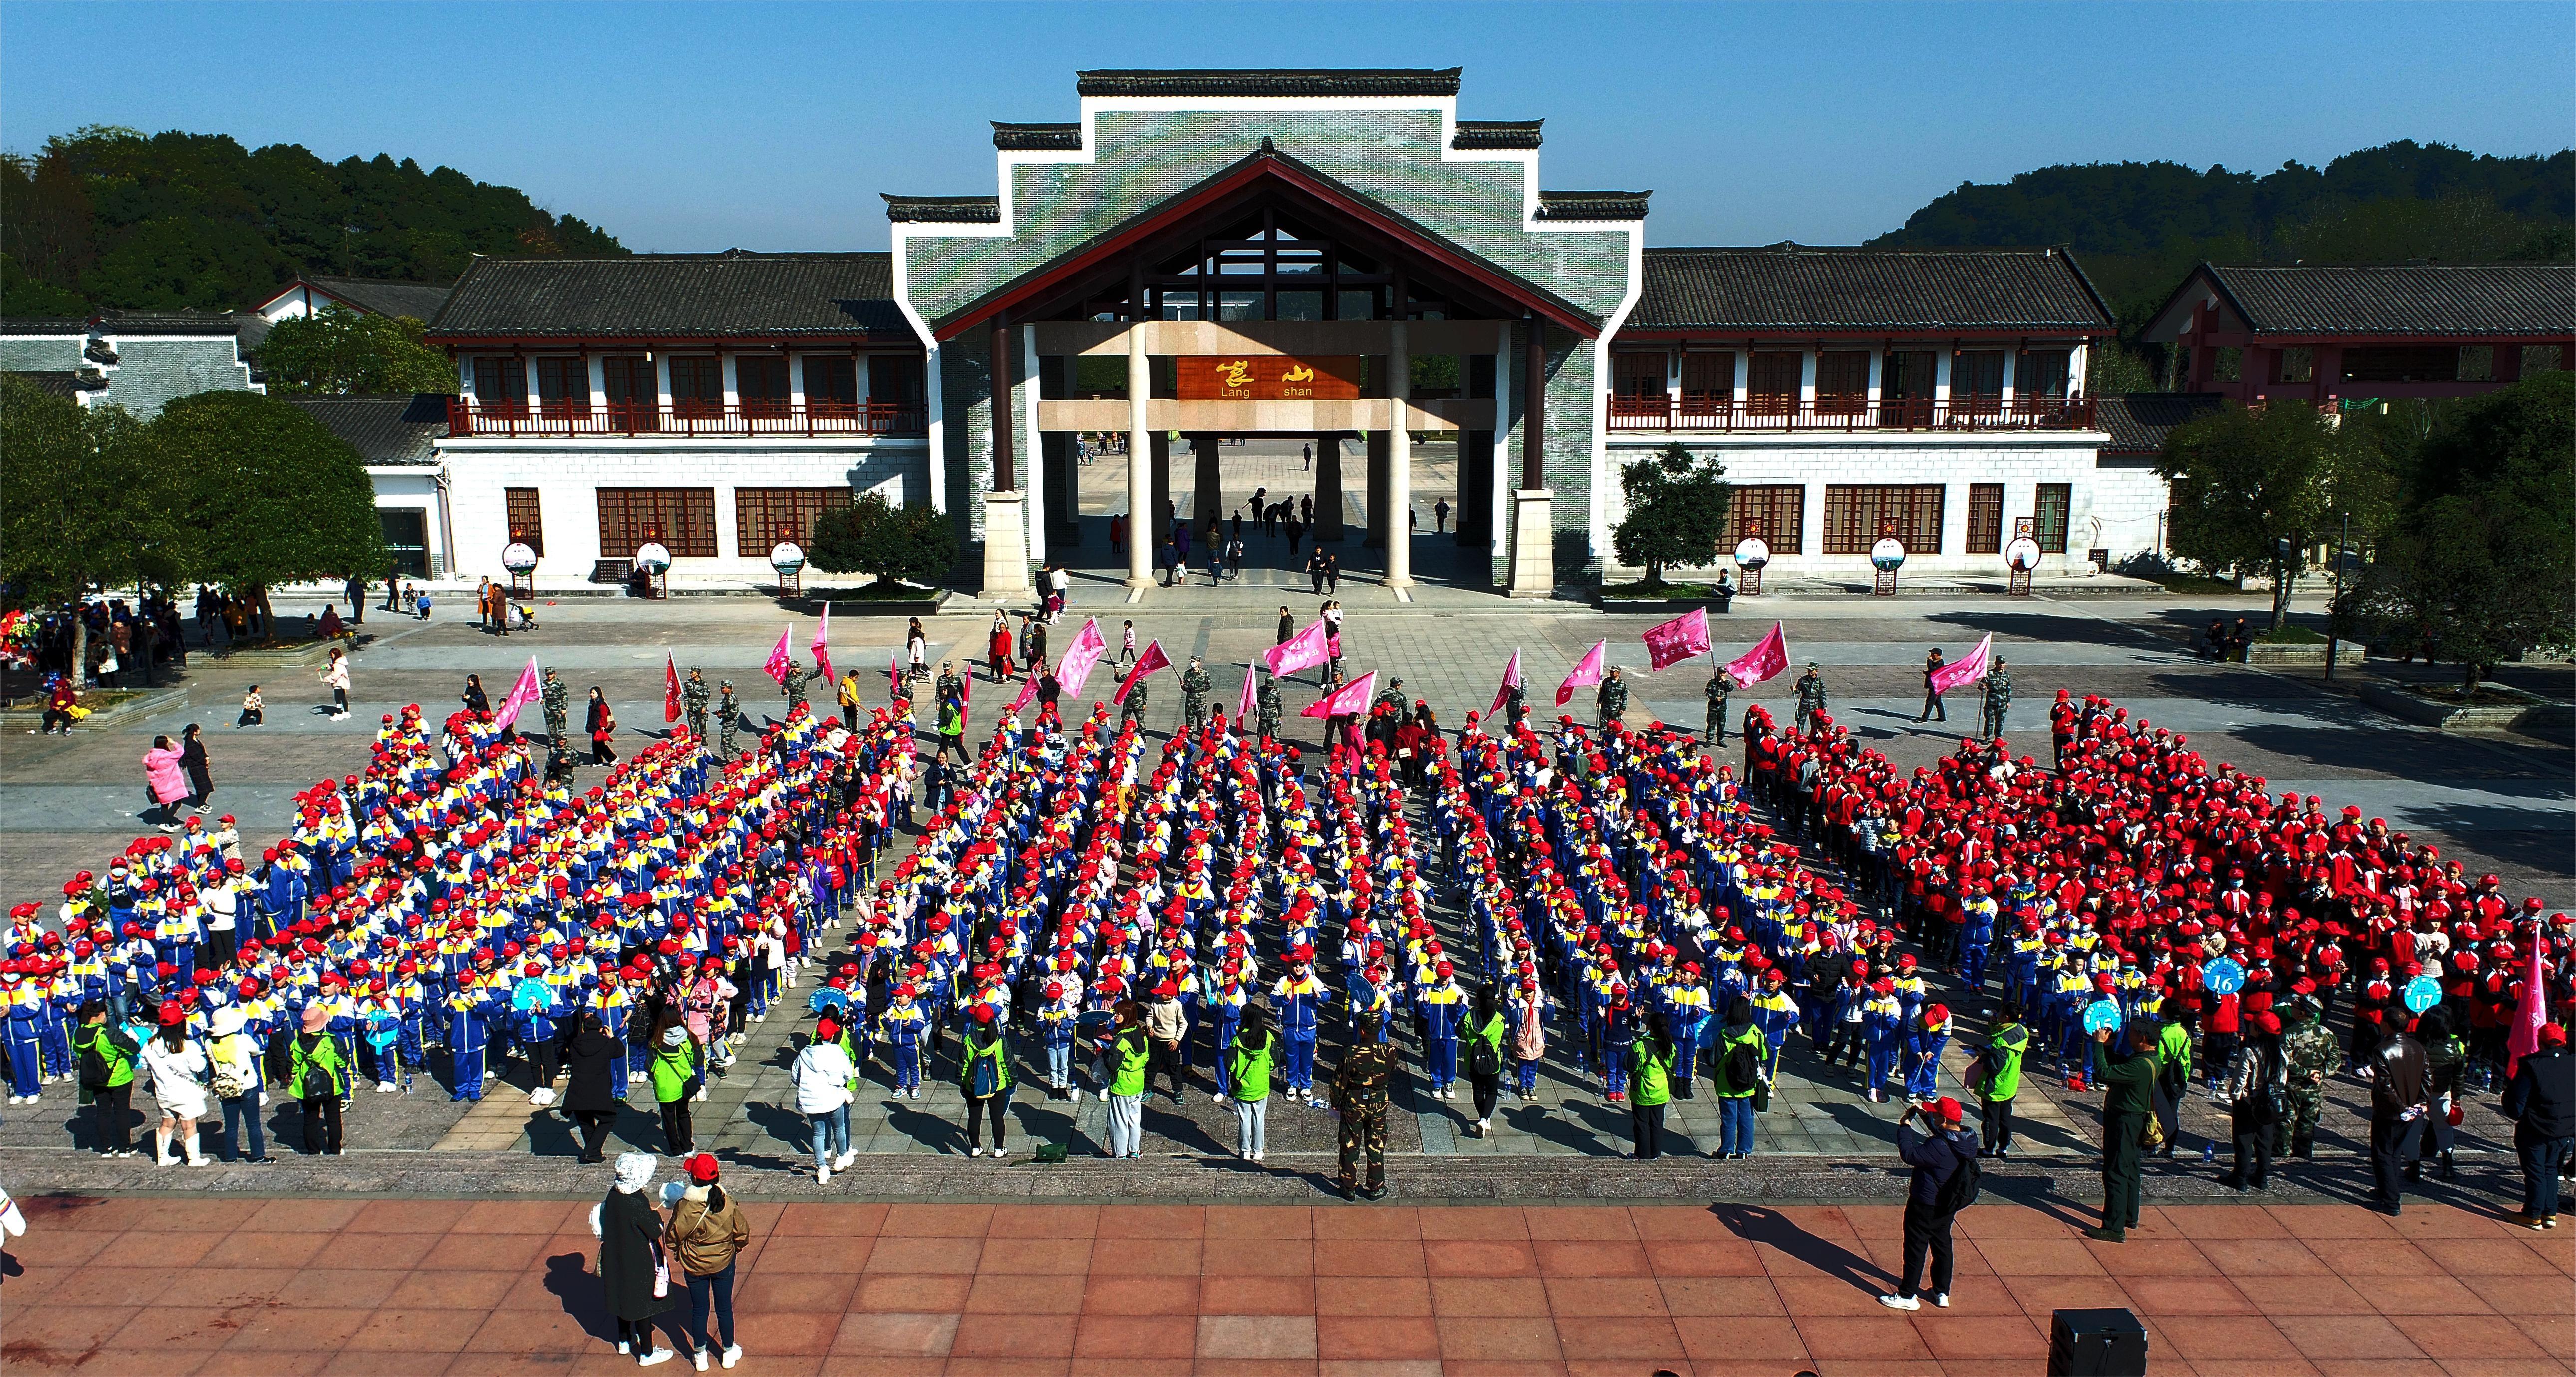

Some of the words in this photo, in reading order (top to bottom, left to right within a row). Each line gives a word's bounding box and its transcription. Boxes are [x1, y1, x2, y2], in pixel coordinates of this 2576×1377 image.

[1221, 387, 1250, 399] Lang
[1284, 387, 1312, 396] shan
[2211, 974, 2234, 991] 16
[1355, 989, 1370, 1003] 10
[2414, 994, 2433, 1010] 17
